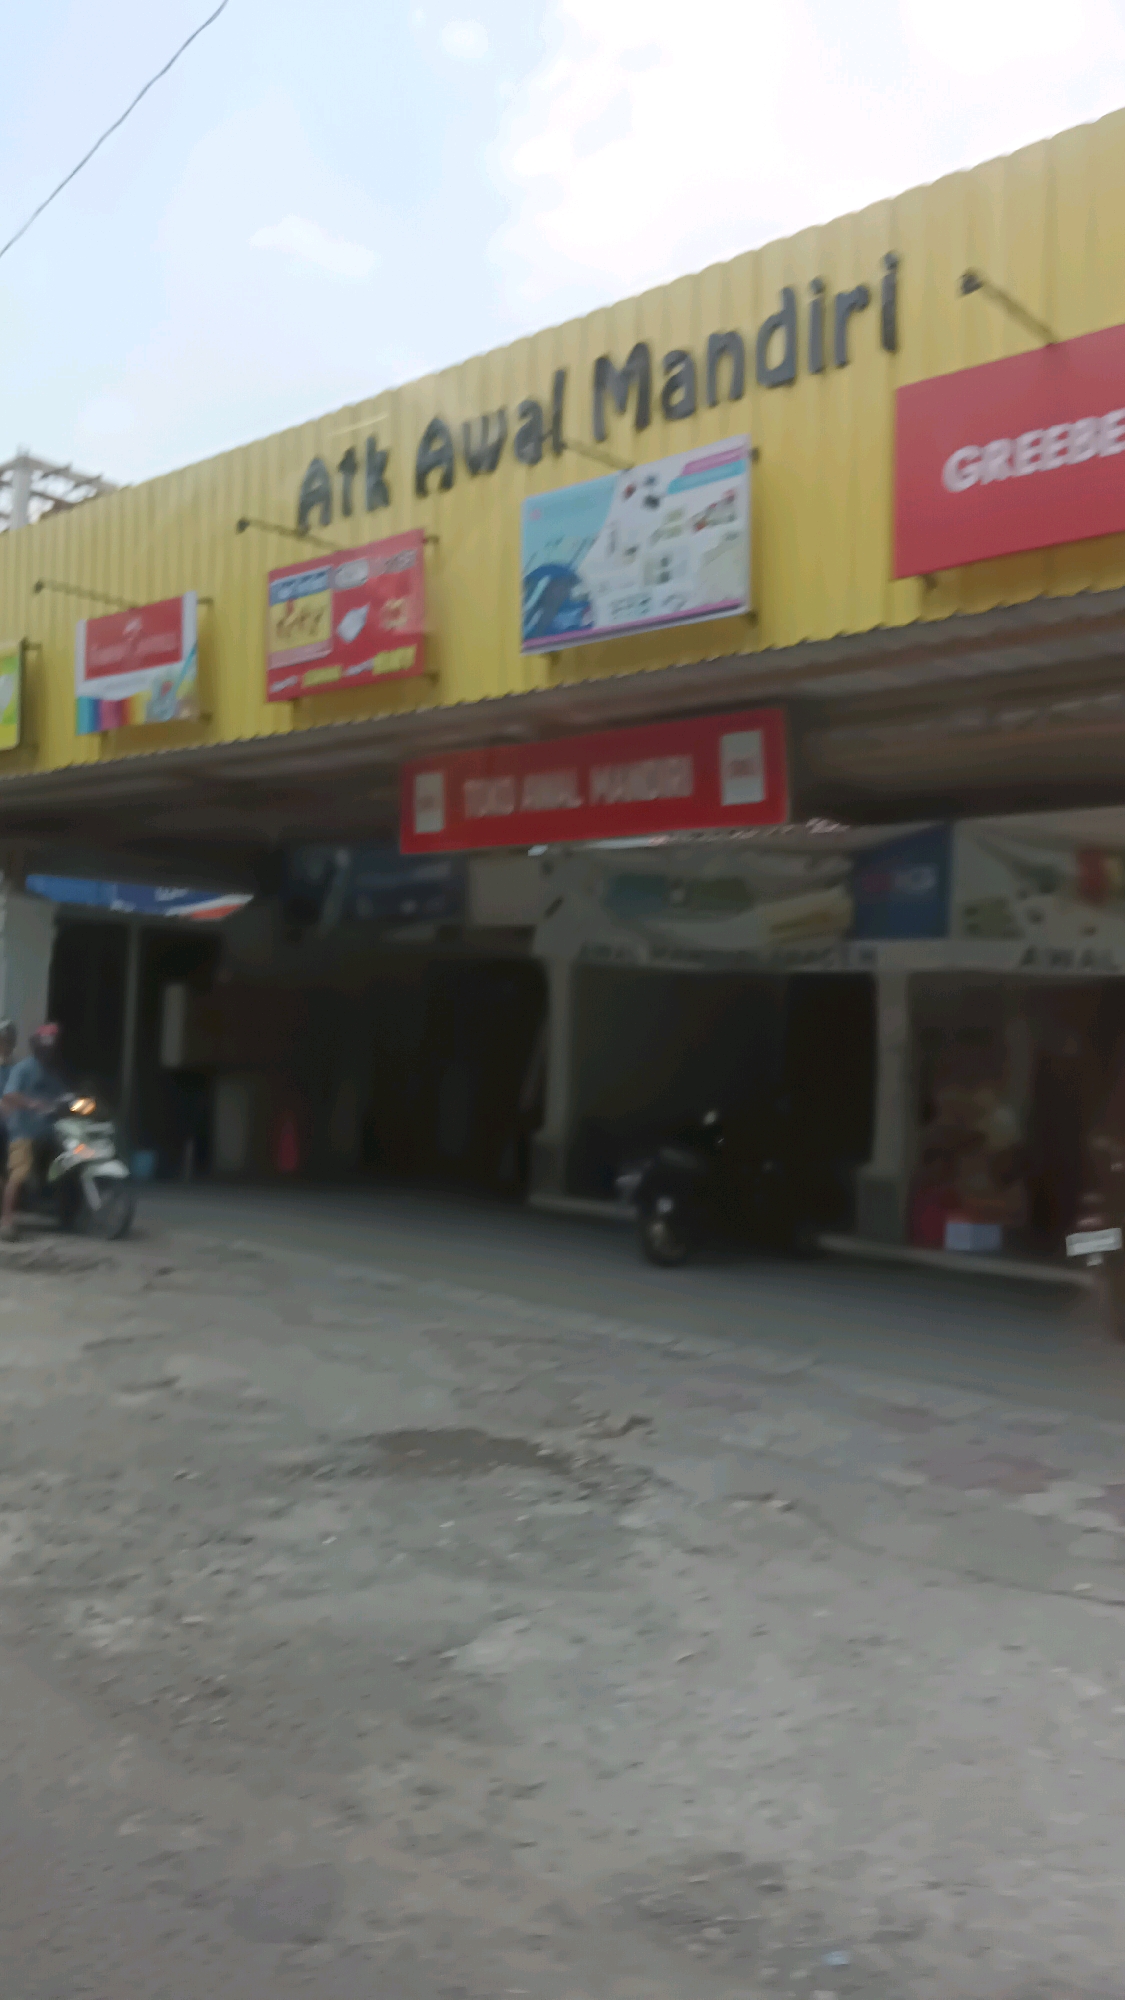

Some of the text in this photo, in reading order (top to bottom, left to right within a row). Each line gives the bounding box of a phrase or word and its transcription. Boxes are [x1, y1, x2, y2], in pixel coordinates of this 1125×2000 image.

[297, 252, 899, 534] Atk Awal Mandiri
